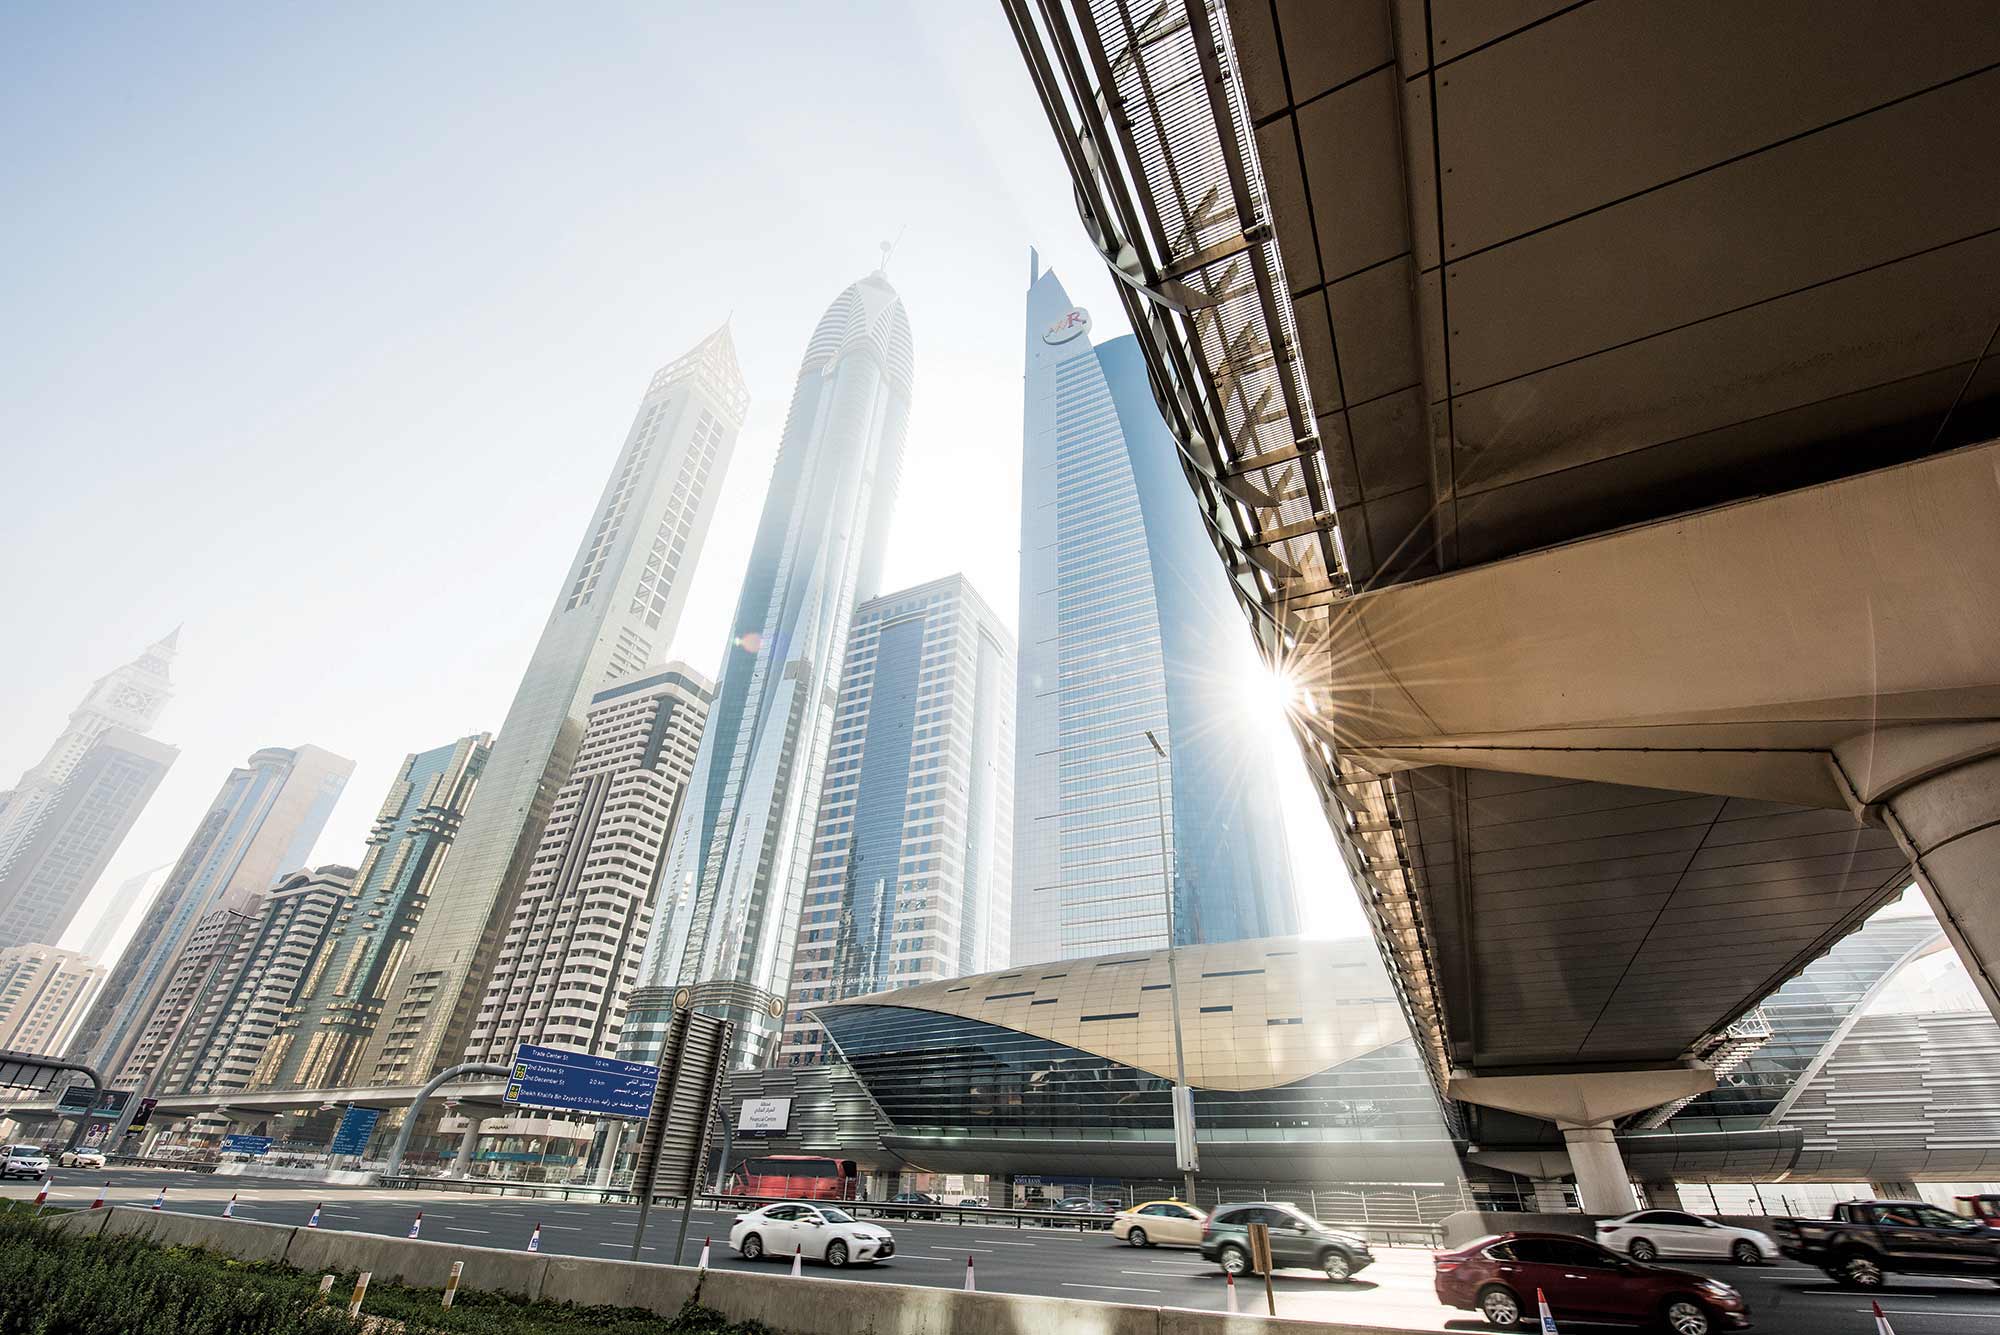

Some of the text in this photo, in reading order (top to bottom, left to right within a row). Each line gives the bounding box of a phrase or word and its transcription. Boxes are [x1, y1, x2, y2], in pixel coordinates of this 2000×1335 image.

[532, 1049, 545, 1057] Trade
[528, 1063, 537, 1071] 2nd
[534, 1075, 558, 1084] December
[520, 1088, 536, 1097] Sheikh
[562, 1095, 577, 1103] Zayed
